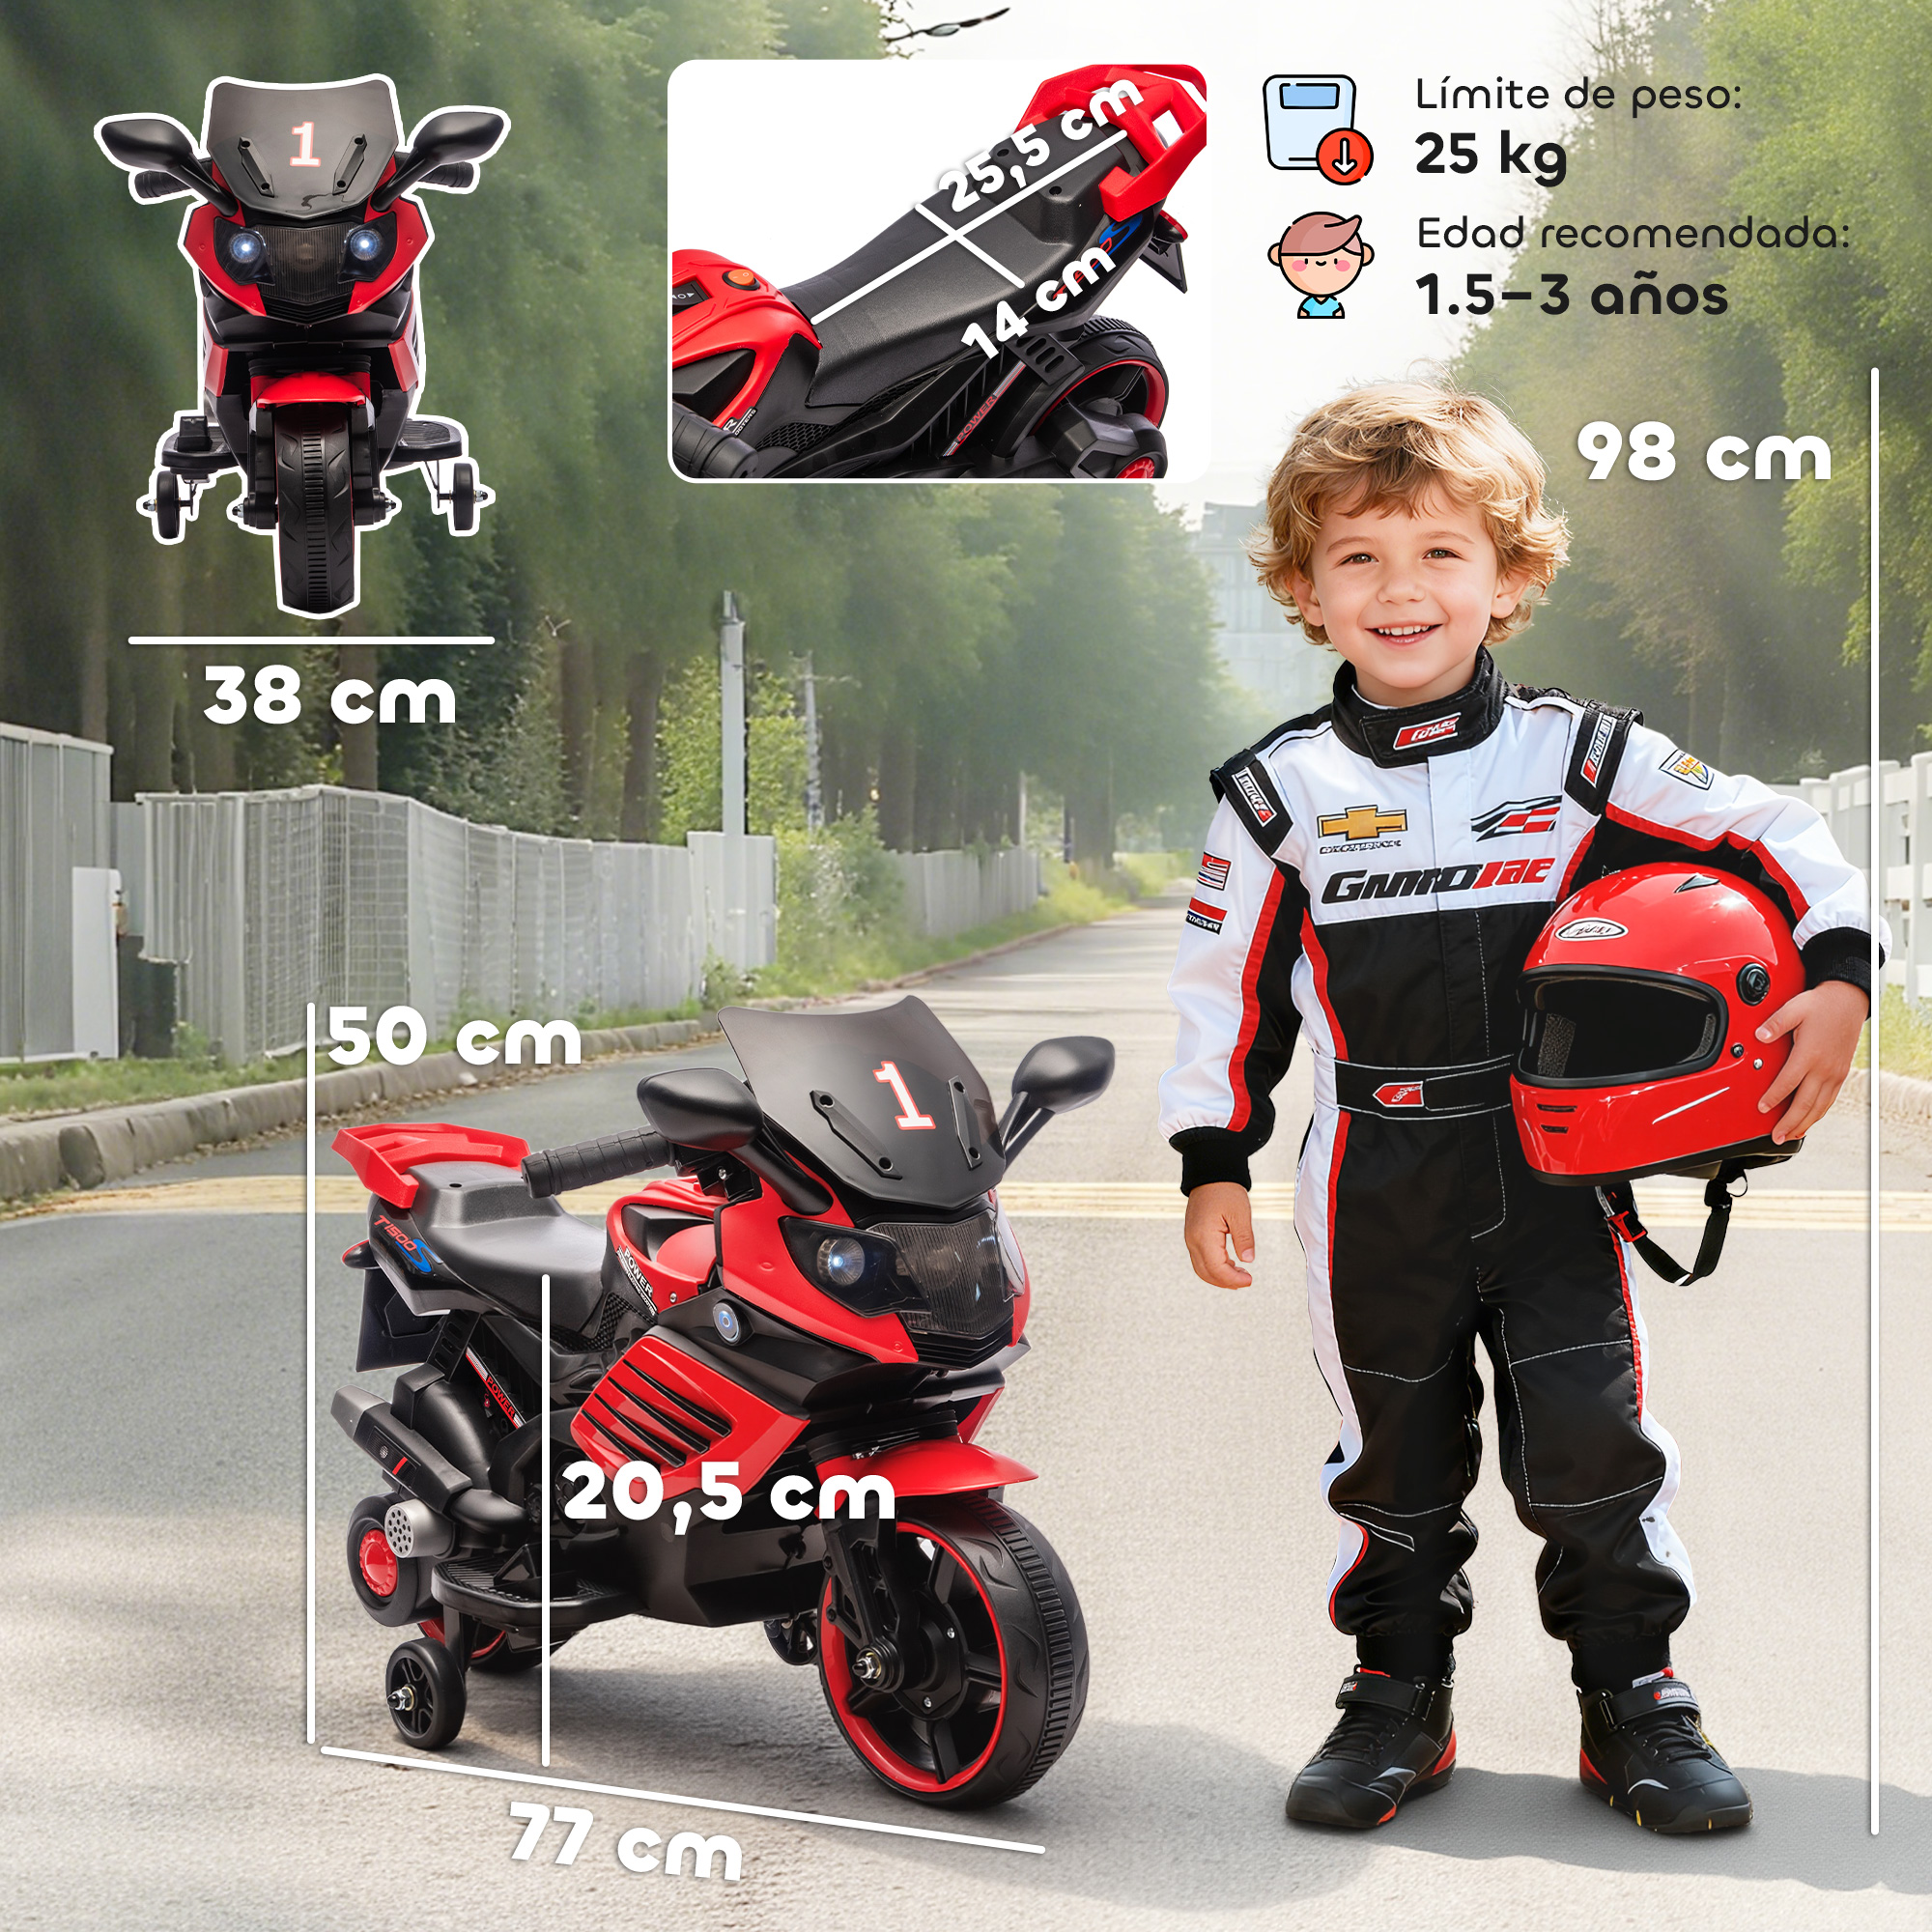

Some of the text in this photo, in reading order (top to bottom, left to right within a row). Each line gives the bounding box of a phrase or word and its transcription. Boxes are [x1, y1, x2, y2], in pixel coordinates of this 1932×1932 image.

[290, 121, 321, 168] 1
[956, 395, 996, 442] POWER
[872, 1061, 936, 1130] 1
[623, 1247, 654, 1298] POWER
[486, 1376, 516, 1418] POWER
